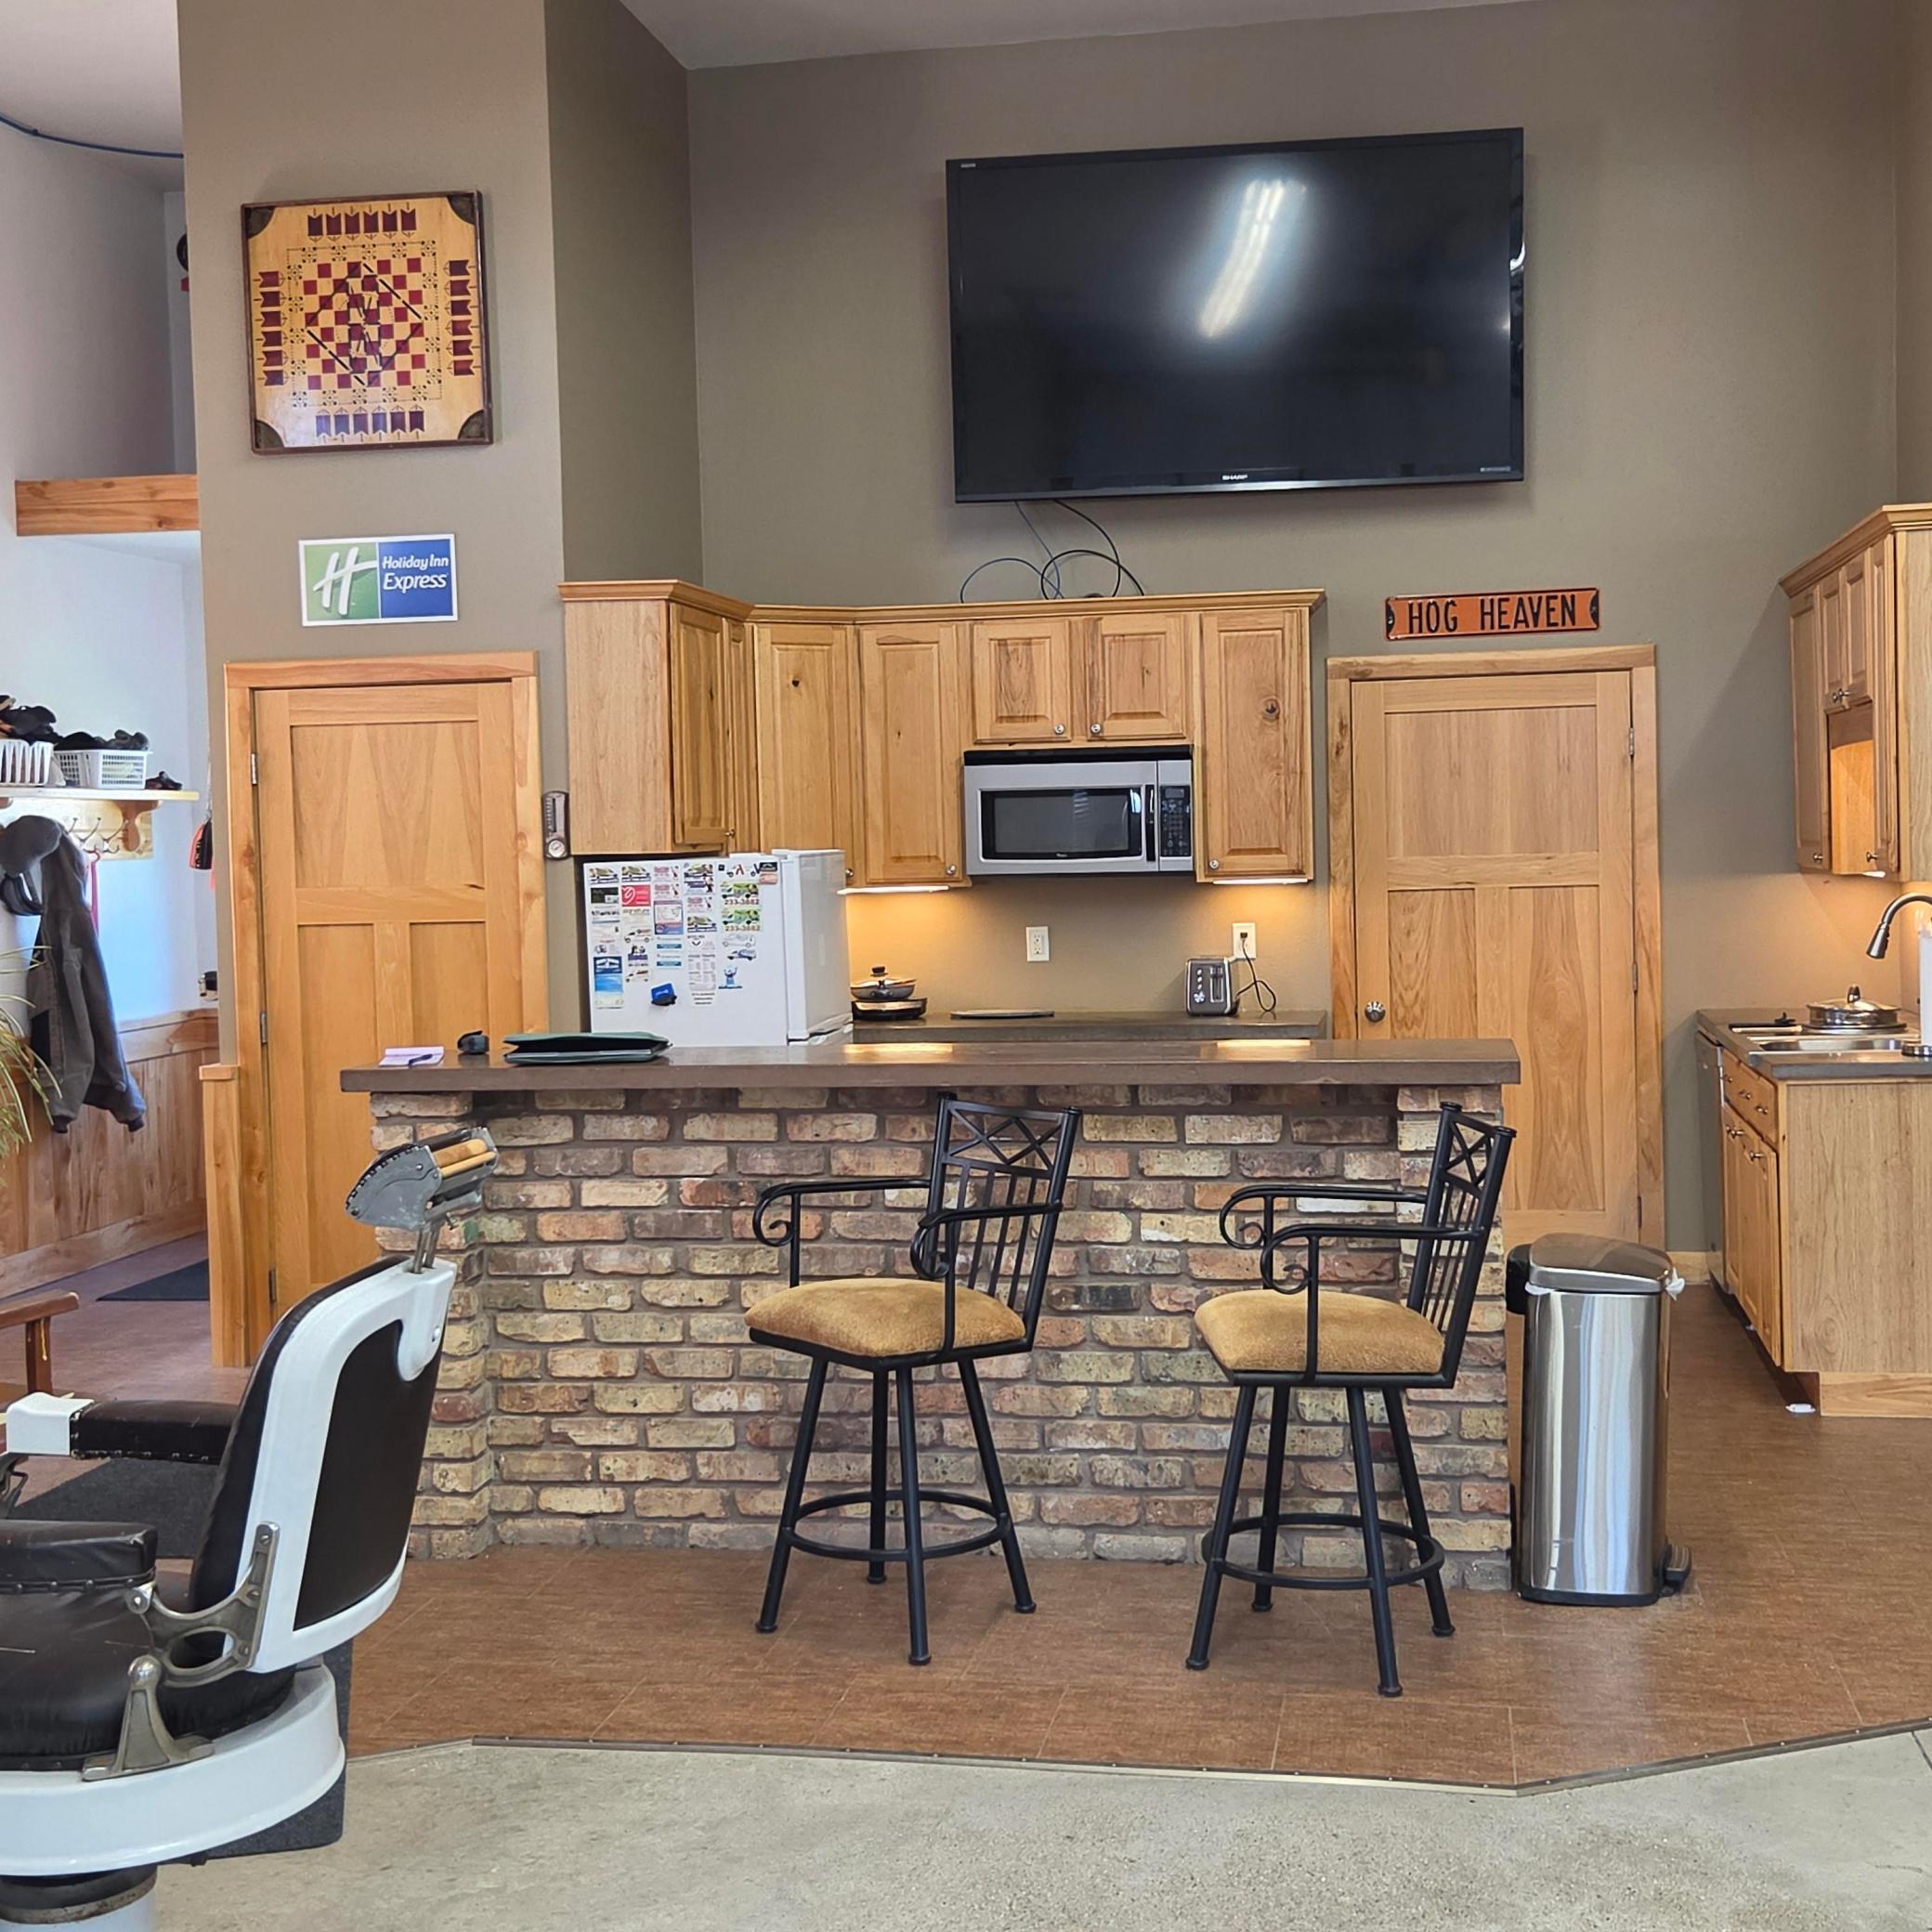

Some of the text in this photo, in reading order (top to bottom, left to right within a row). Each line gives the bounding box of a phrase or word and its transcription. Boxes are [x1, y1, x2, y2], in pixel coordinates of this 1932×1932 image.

[382, 554, 450, 570] Holiday Inn
[383, 572, 448, 594] Express
[1407, 594, 1576, 634] HOG HEAVEN
